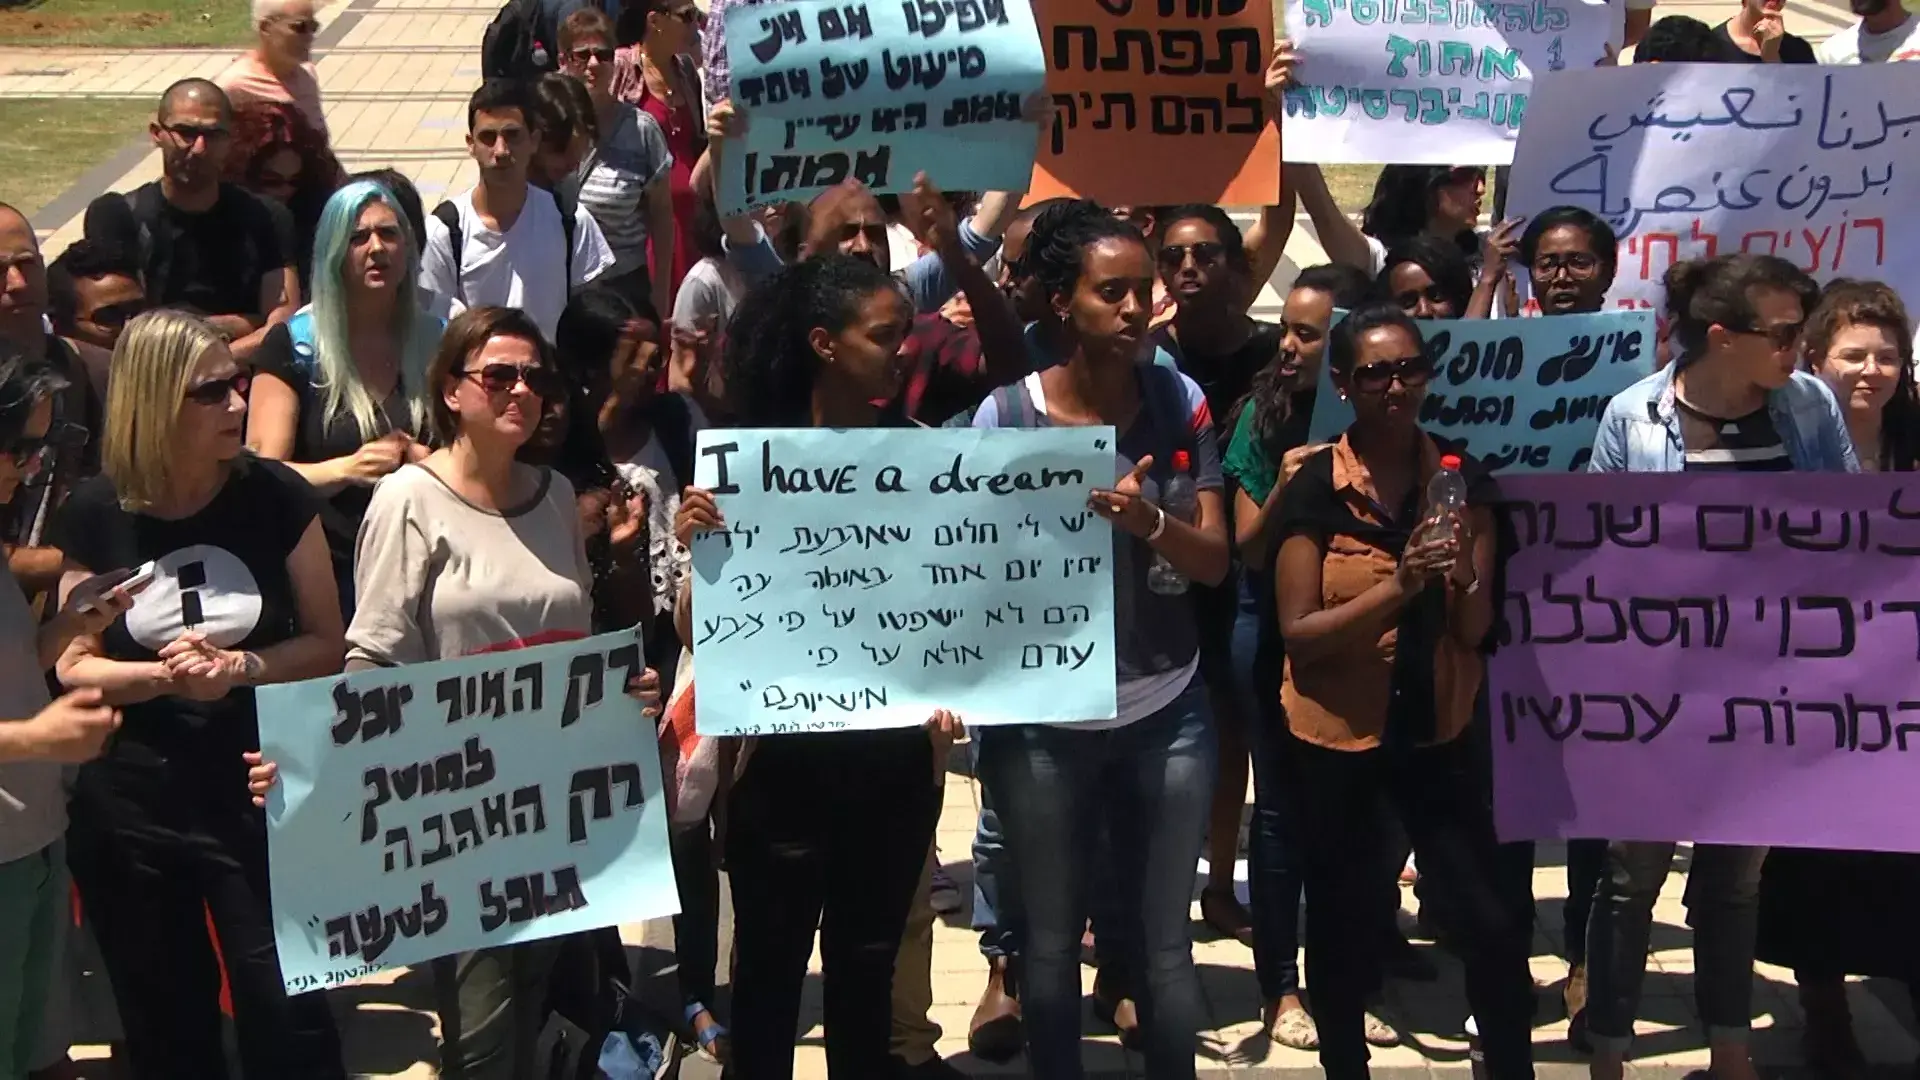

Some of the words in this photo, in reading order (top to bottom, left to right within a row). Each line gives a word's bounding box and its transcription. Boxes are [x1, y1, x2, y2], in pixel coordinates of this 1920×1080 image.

[749, 9, 808, 64] אני
[817, 3, 873, 42] אם
[882, 45, 986, 91] מיעוט
[1053, 25, 1261, 76] תפתח
[1385, 33, 1522, 82] אחוז
[739, 67, 811, 107] אחד
[820, 56, 869, 99] של
[871, 102, 927, 134] היא
[943, 91, 1022, 127] אמת
[1051, 91, 1136, 155] תיק
[1152, 83, 1263, 135] להם
[1588, 86, 1804, 143] نعيش
[784, 111, 861, 150] עדיין
[1777, 160, 1893, 220] بدون
[702, 442, 739, 496] I
[761, 439, 857, 495] have
[875, 465, 911, 493] a
[779, 523, 911, 556] שארבעת
[934, 517, 998, 546] חלום
[1017, 513, 1039, 538] לי
[1060, 511, 1094, 532] יש
[729, 572, 772, 602] בה
[805, 565, 893, 590] באומה
[921, 563, 987, 585] אחד
[1005, 559, 1042, 582] יום
[697, 611, 765, 646] צבע
[778, 610, 805, 632] פי
[822, 603, 856, 628] על
[985, 601, 1024, 628] לא
[1043, 604, 1090, 625] הם
[808, 646, 838, 668] פי
[861, 641, 901, 667] על
[923, 640, 984, 668] אלא
[1021, 641, 1095, 672] עורם
[331, 677, 414, 747] יוכל
[436, 661, 543, 726] האור
[1501, 691, 1681, 744] עכשיו
[567, 762, 646, 844] רק
[384, 784, 548, 874] האהבה
[478, 864, 590, 933] תוכל
